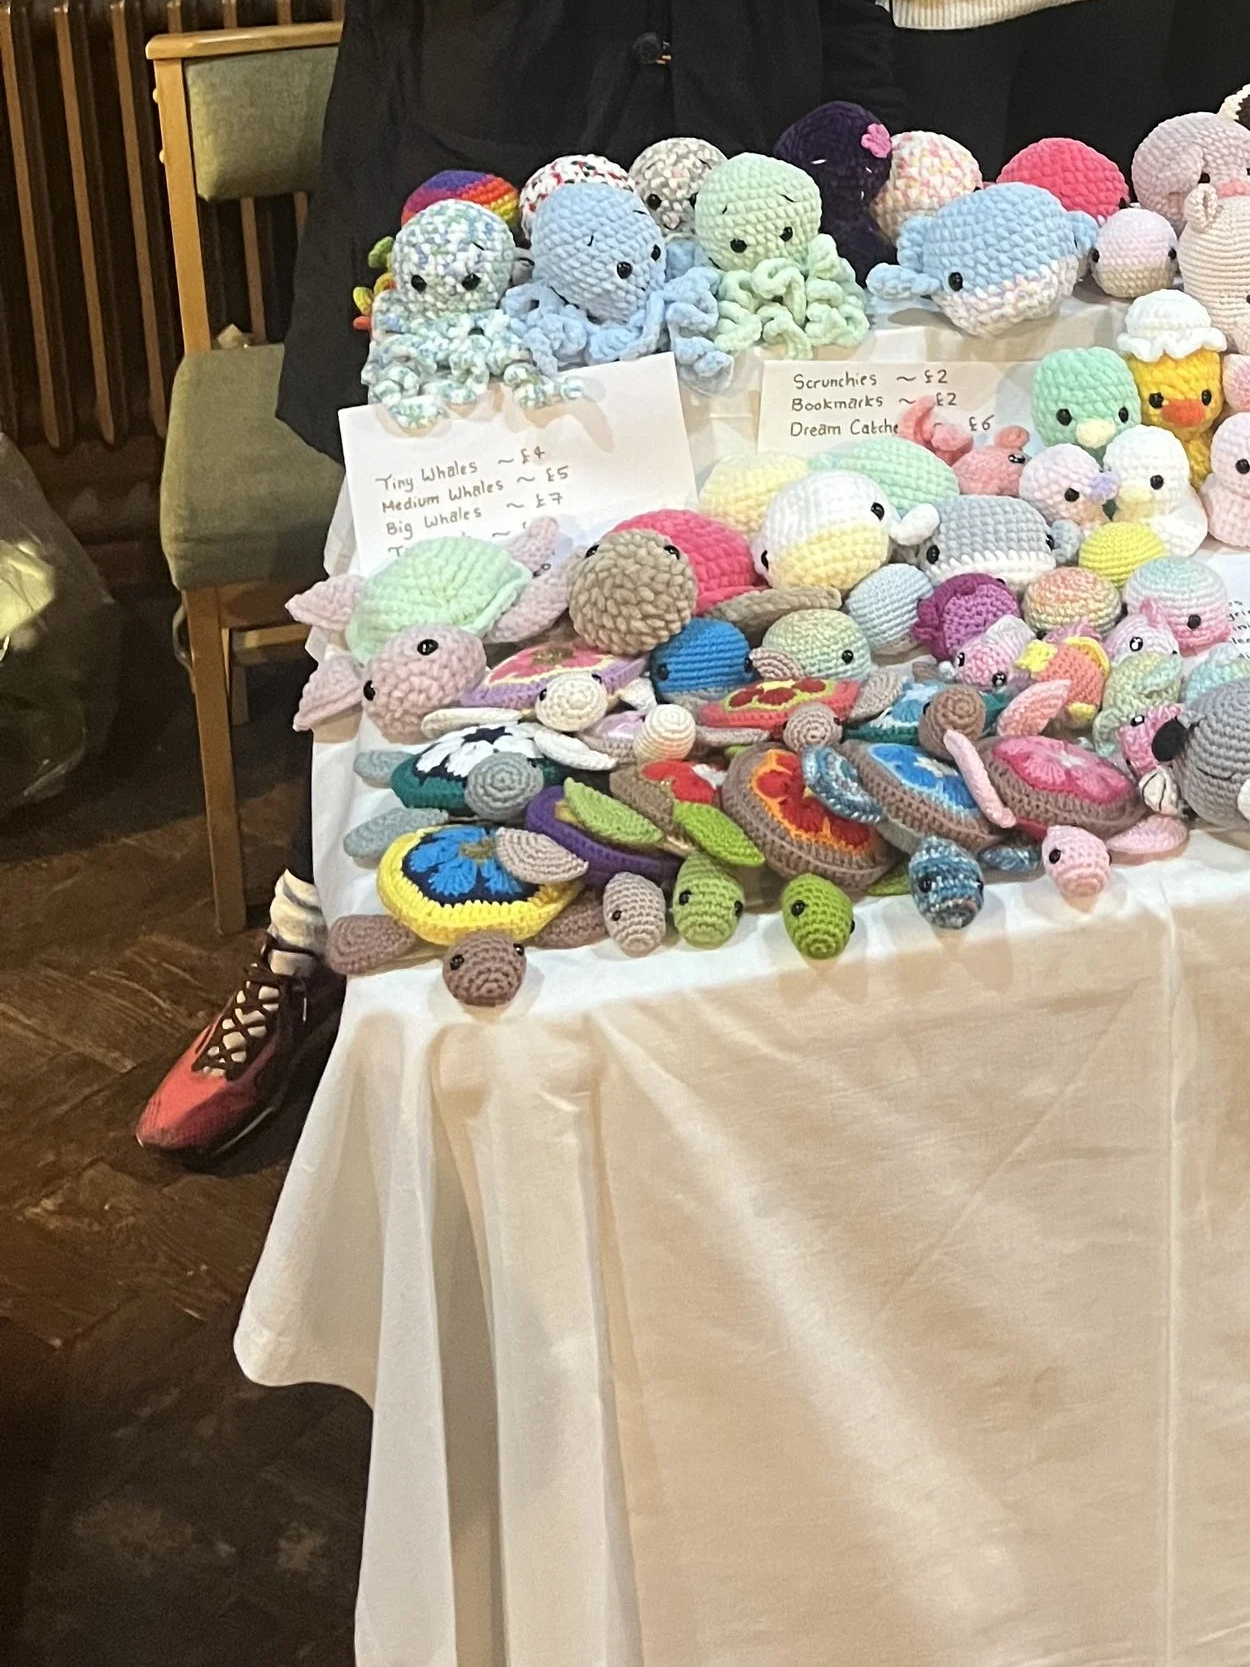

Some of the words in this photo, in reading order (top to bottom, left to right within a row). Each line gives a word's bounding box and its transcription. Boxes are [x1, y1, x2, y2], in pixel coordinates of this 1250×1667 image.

[793, 370, 877, 390] Scrunchies
[924, 368, 949, 385] £2
[791, 394, 884, 412] Bookmarks
[935, 392, 958, 408] £2
[790, 421, 841, 438] Dream
[849, 418, 899, 436] Catche
[968, 414, 996, 432] £6
[374, 473, 414, 494] Tiny
[421, 460, 479, 483] Whales
[520, 445, 546, 465] £4
[381, 495, 440, 514] Medium
[449, 479, 504, 502] Whales
[546, 465, 569, 483] £5
[385, 521, 413, 540] Big
[424, 505, 482, 529] Whales
[535, 491, 564, 509] £7
